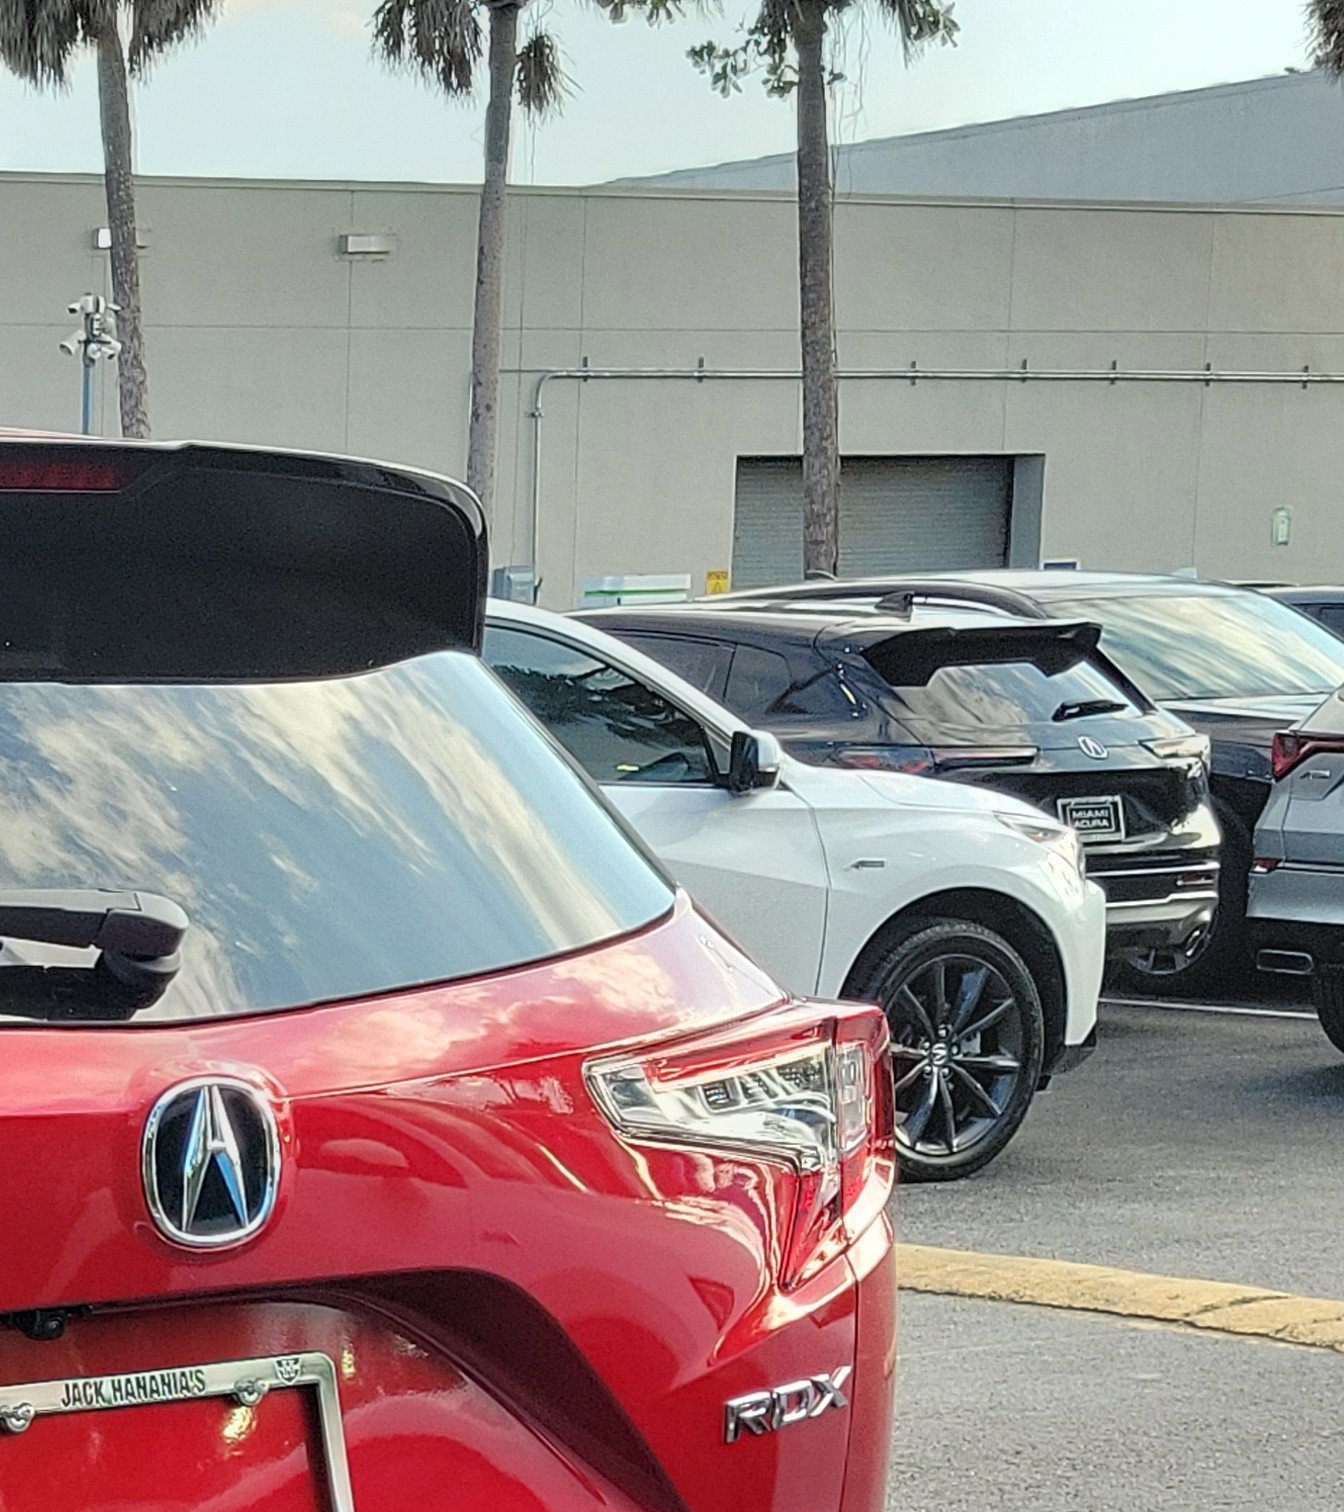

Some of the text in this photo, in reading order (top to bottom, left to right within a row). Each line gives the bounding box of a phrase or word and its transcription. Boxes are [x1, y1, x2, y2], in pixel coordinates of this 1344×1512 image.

[1072, 809, 1109, 819] MIAMI
[62, 1369, 206, 1407] JACK HANANIA'S
[724, 1365, 852, 1443] RDX
